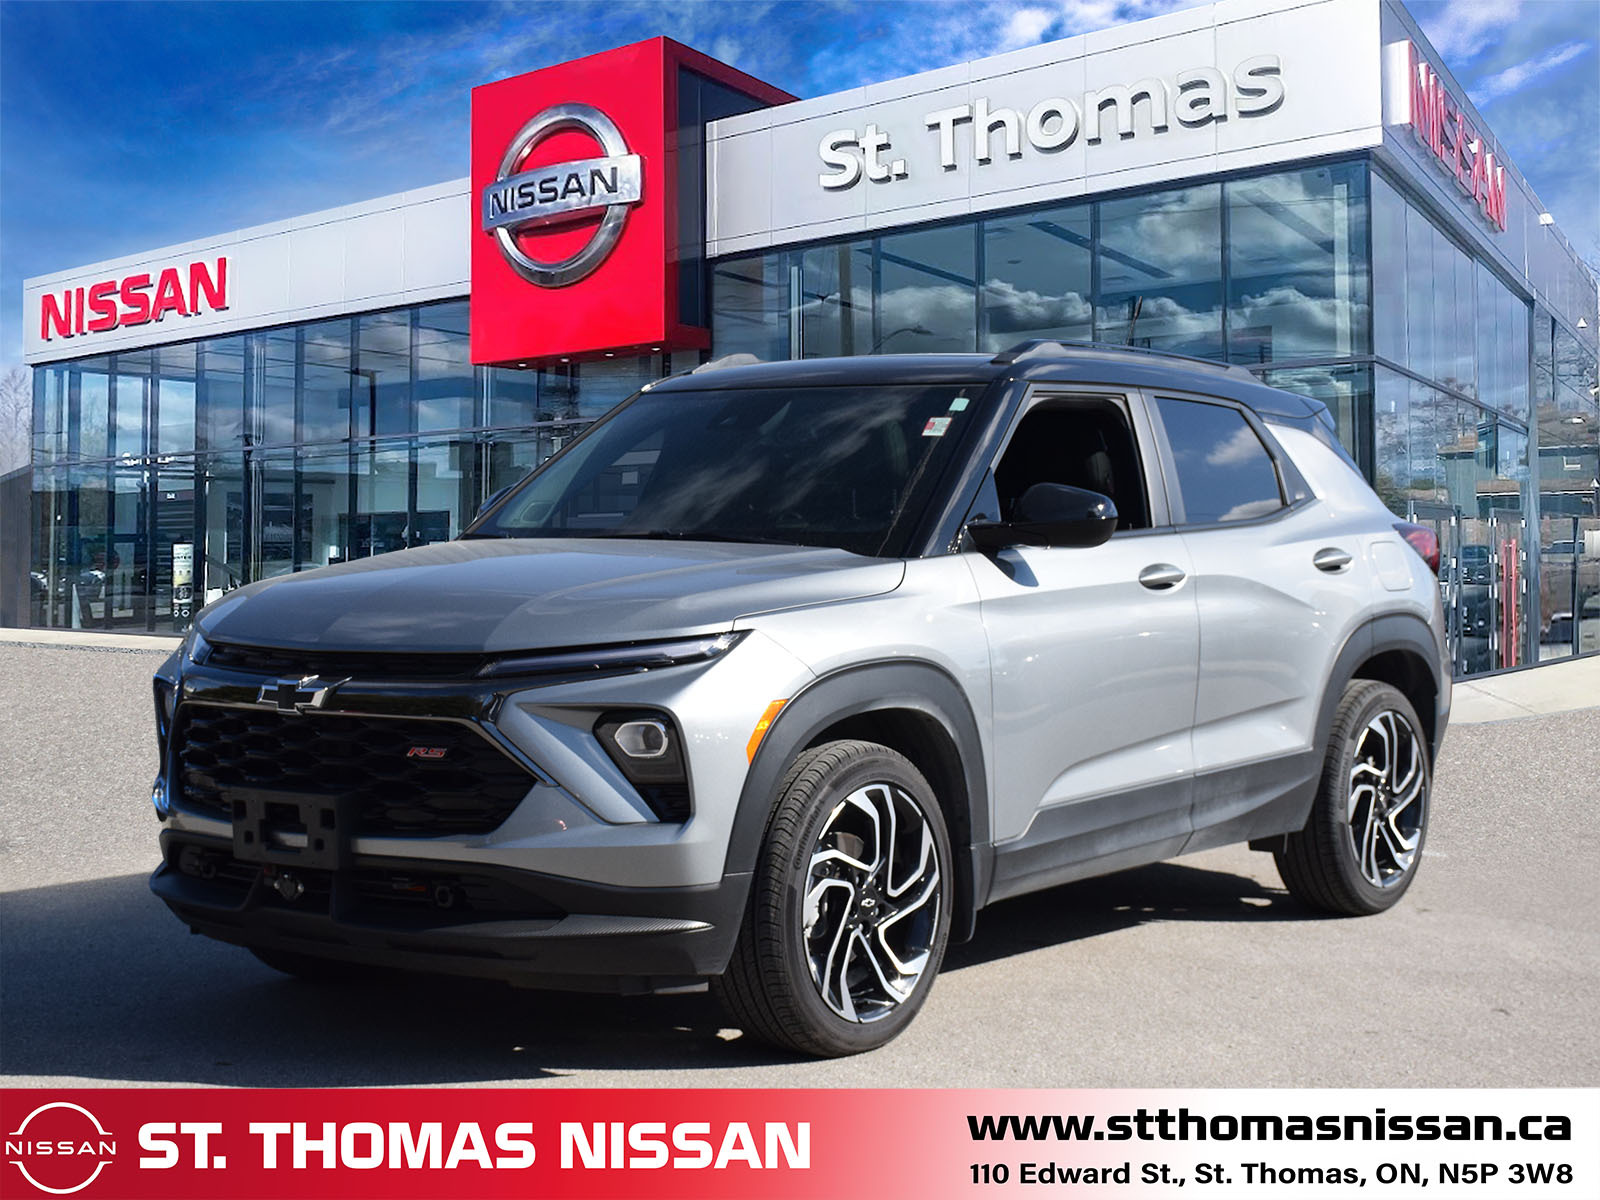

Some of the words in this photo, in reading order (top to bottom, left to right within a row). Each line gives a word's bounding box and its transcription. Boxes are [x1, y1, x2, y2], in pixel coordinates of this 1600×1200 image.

[819, 124, 908, 191] St.
[924, 54, 1286, 171] Thomas
[489, 164, 619, 219] NISSAN
[41, 257, 229, 341] NISSAN
[406, 746, 447, 758] RS
[793, 804, 822, 871] Continental
